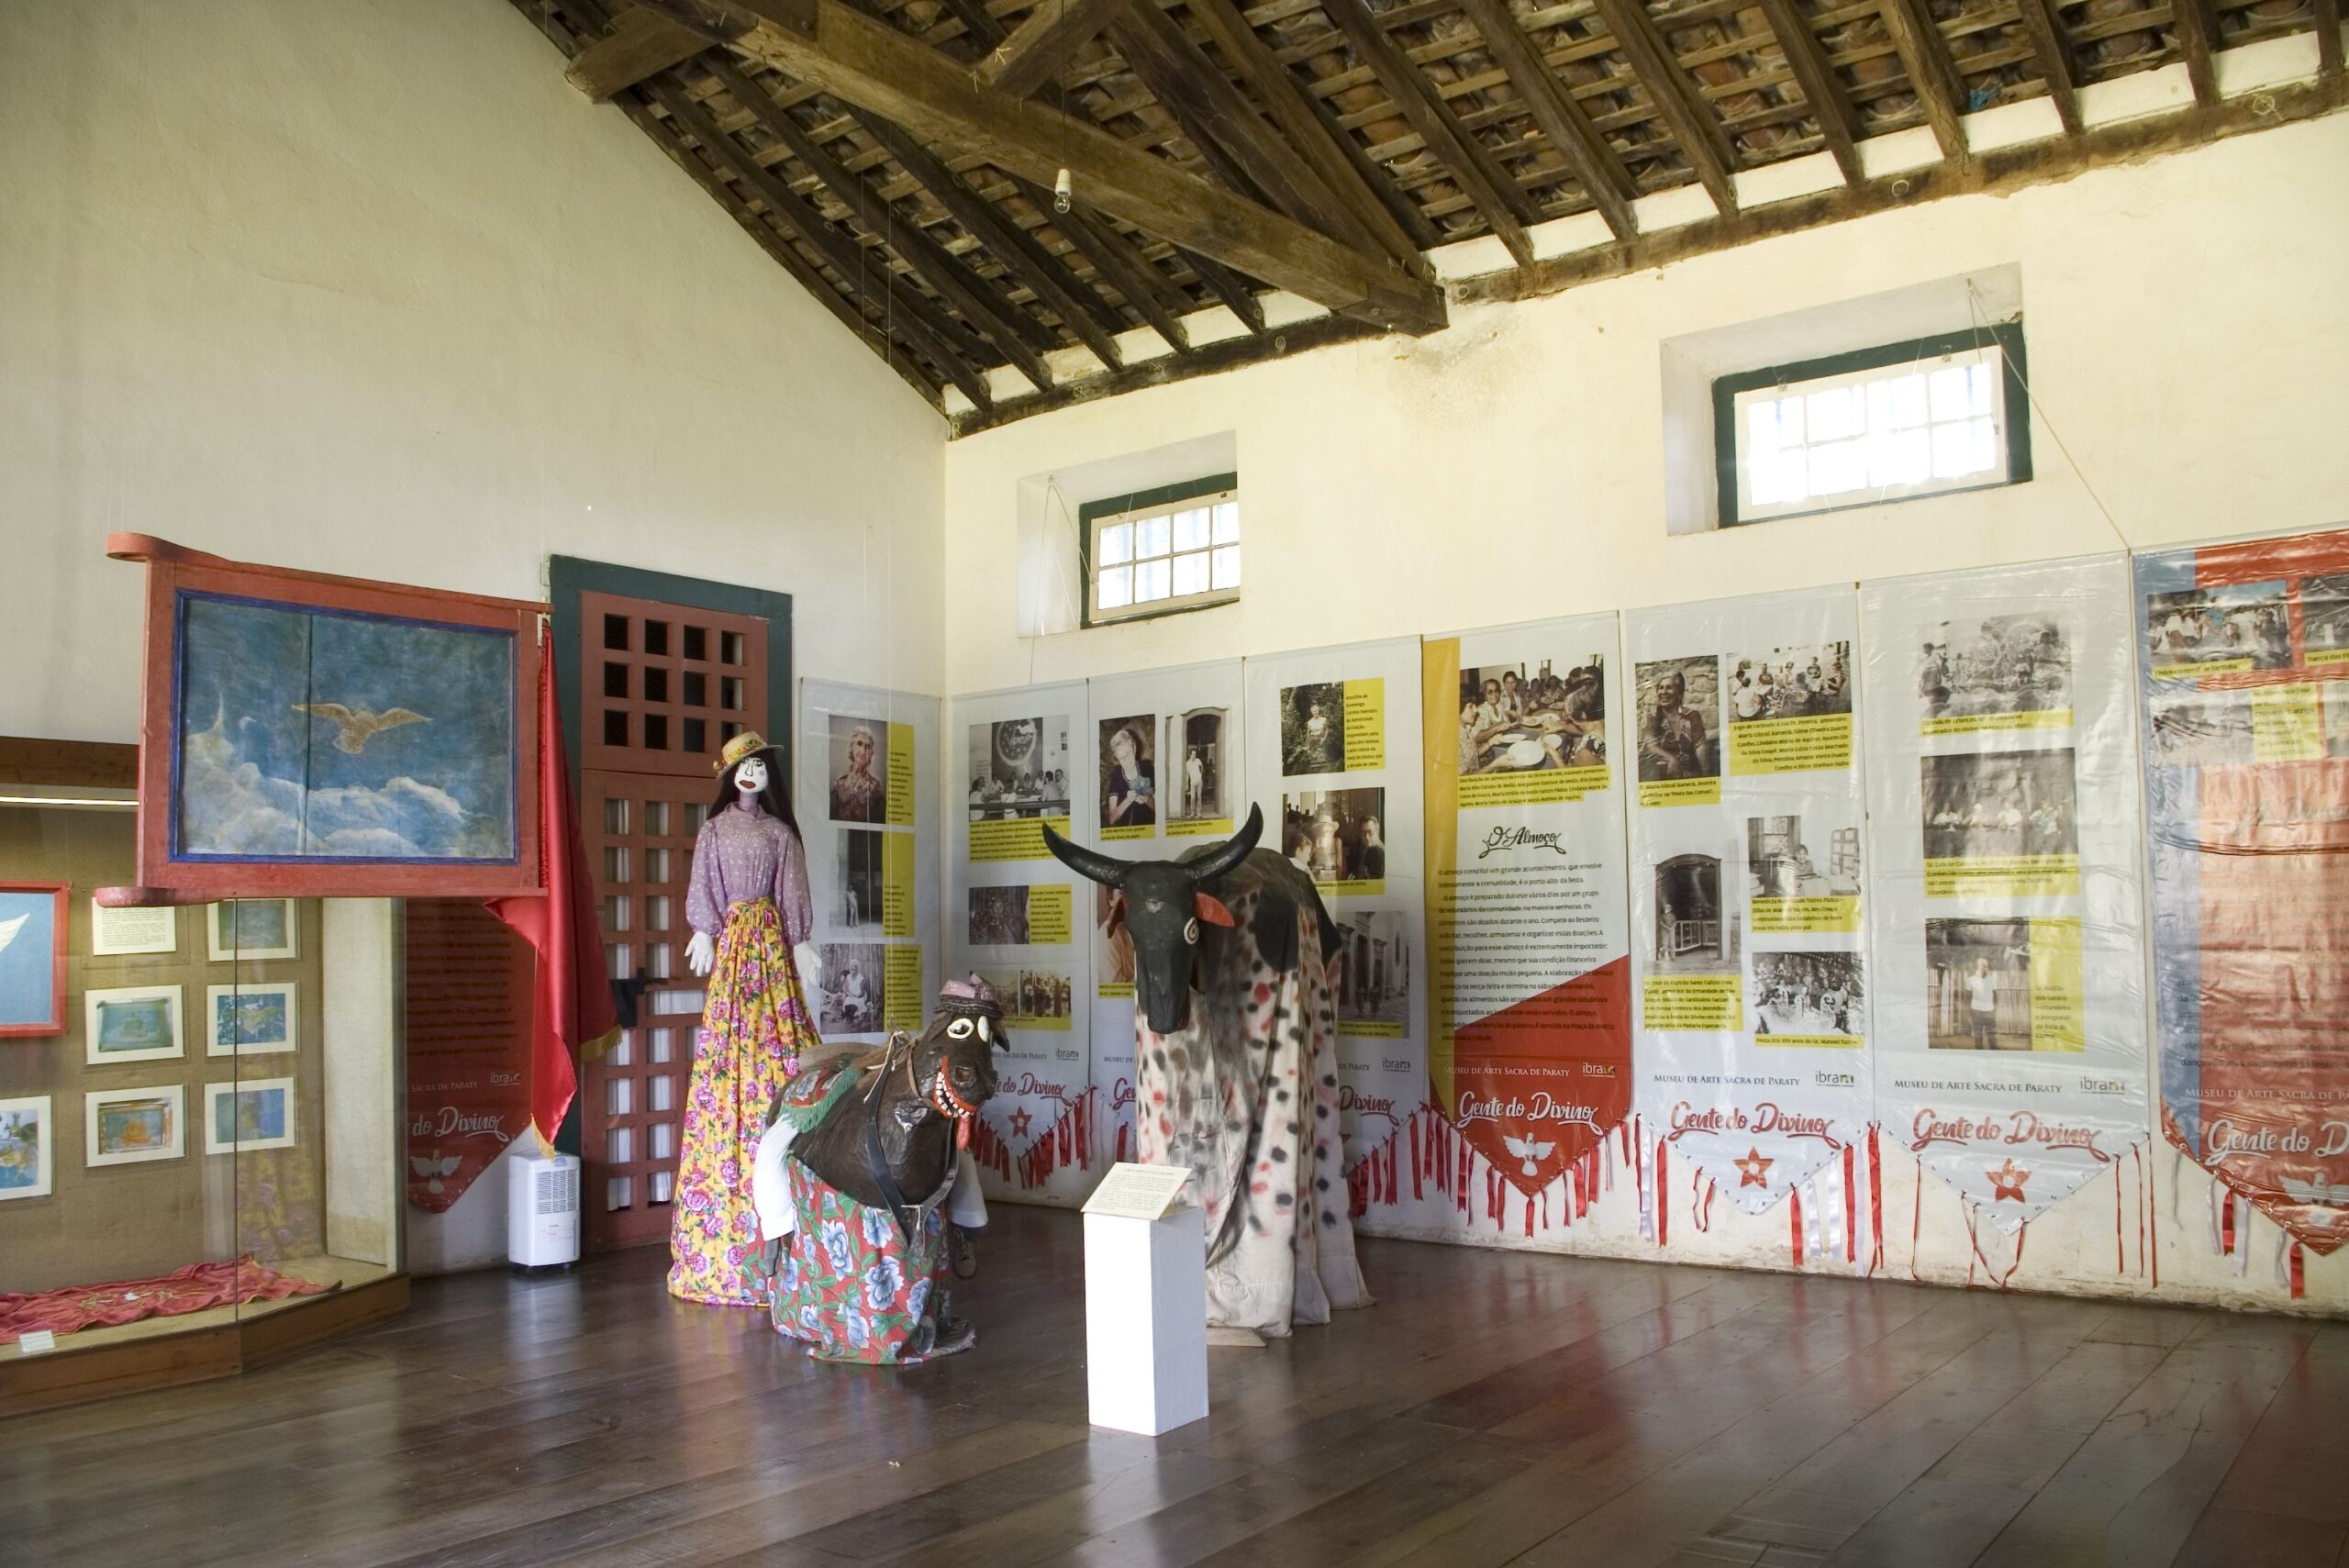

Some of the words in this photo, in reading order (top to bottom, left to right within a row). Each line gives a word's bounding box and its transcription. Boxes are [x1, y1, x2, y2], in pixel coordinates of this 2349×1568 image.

[1502, 827, 1565, 854] Almoço
[1483, 1067, 1503, 1075] ARTE
[1531, 1068, 1542, 1076] DE
[1542, 1068, 1570, 1077] PARATY
[1698, 1075, 1720, 1084] ARTE
[1725, 1076, 1751, 1084] SACRA
[1768, 1077, 1800, 1086] PARATY
[1004, 1076, 1016, 1093] do
[1895, 1080, 1929, 1088] MUSEU
[1932, 1081, 1943, 1089] DE
[1945, 1081, 1972, 1090] ARTE
[1974, 1082, 2005, 1091] SACRA
[2009, 1083, 2022, 1092] DE
[2026, 1083, 2062, 1093] PARATY
[2184, 1088, 2224, 1097] MUSEU
[2228, 1089, 2242, 1097] DE
[2246, 1089, 2276, 1098] ARTE
[2278, 1090, 2314, 1099] SACRA
[2319, 1090, 2333, 1100] DE
[1457, 1091, 1506, 1129] Gente
[1506, 1097, 1526, 1117] do
[413, 1115, 431, 1136] do
[1668, 1101, 1723, 1141] Gente
[1725, 1107, 1747, 1129] do
[1910, 1108, 1973, 1151] Gente
[1976, 1117, 2000, 1140] do
[2204, 1119, 2277, 1166] Gente
[2282, 1127, 2310, 1151] do
